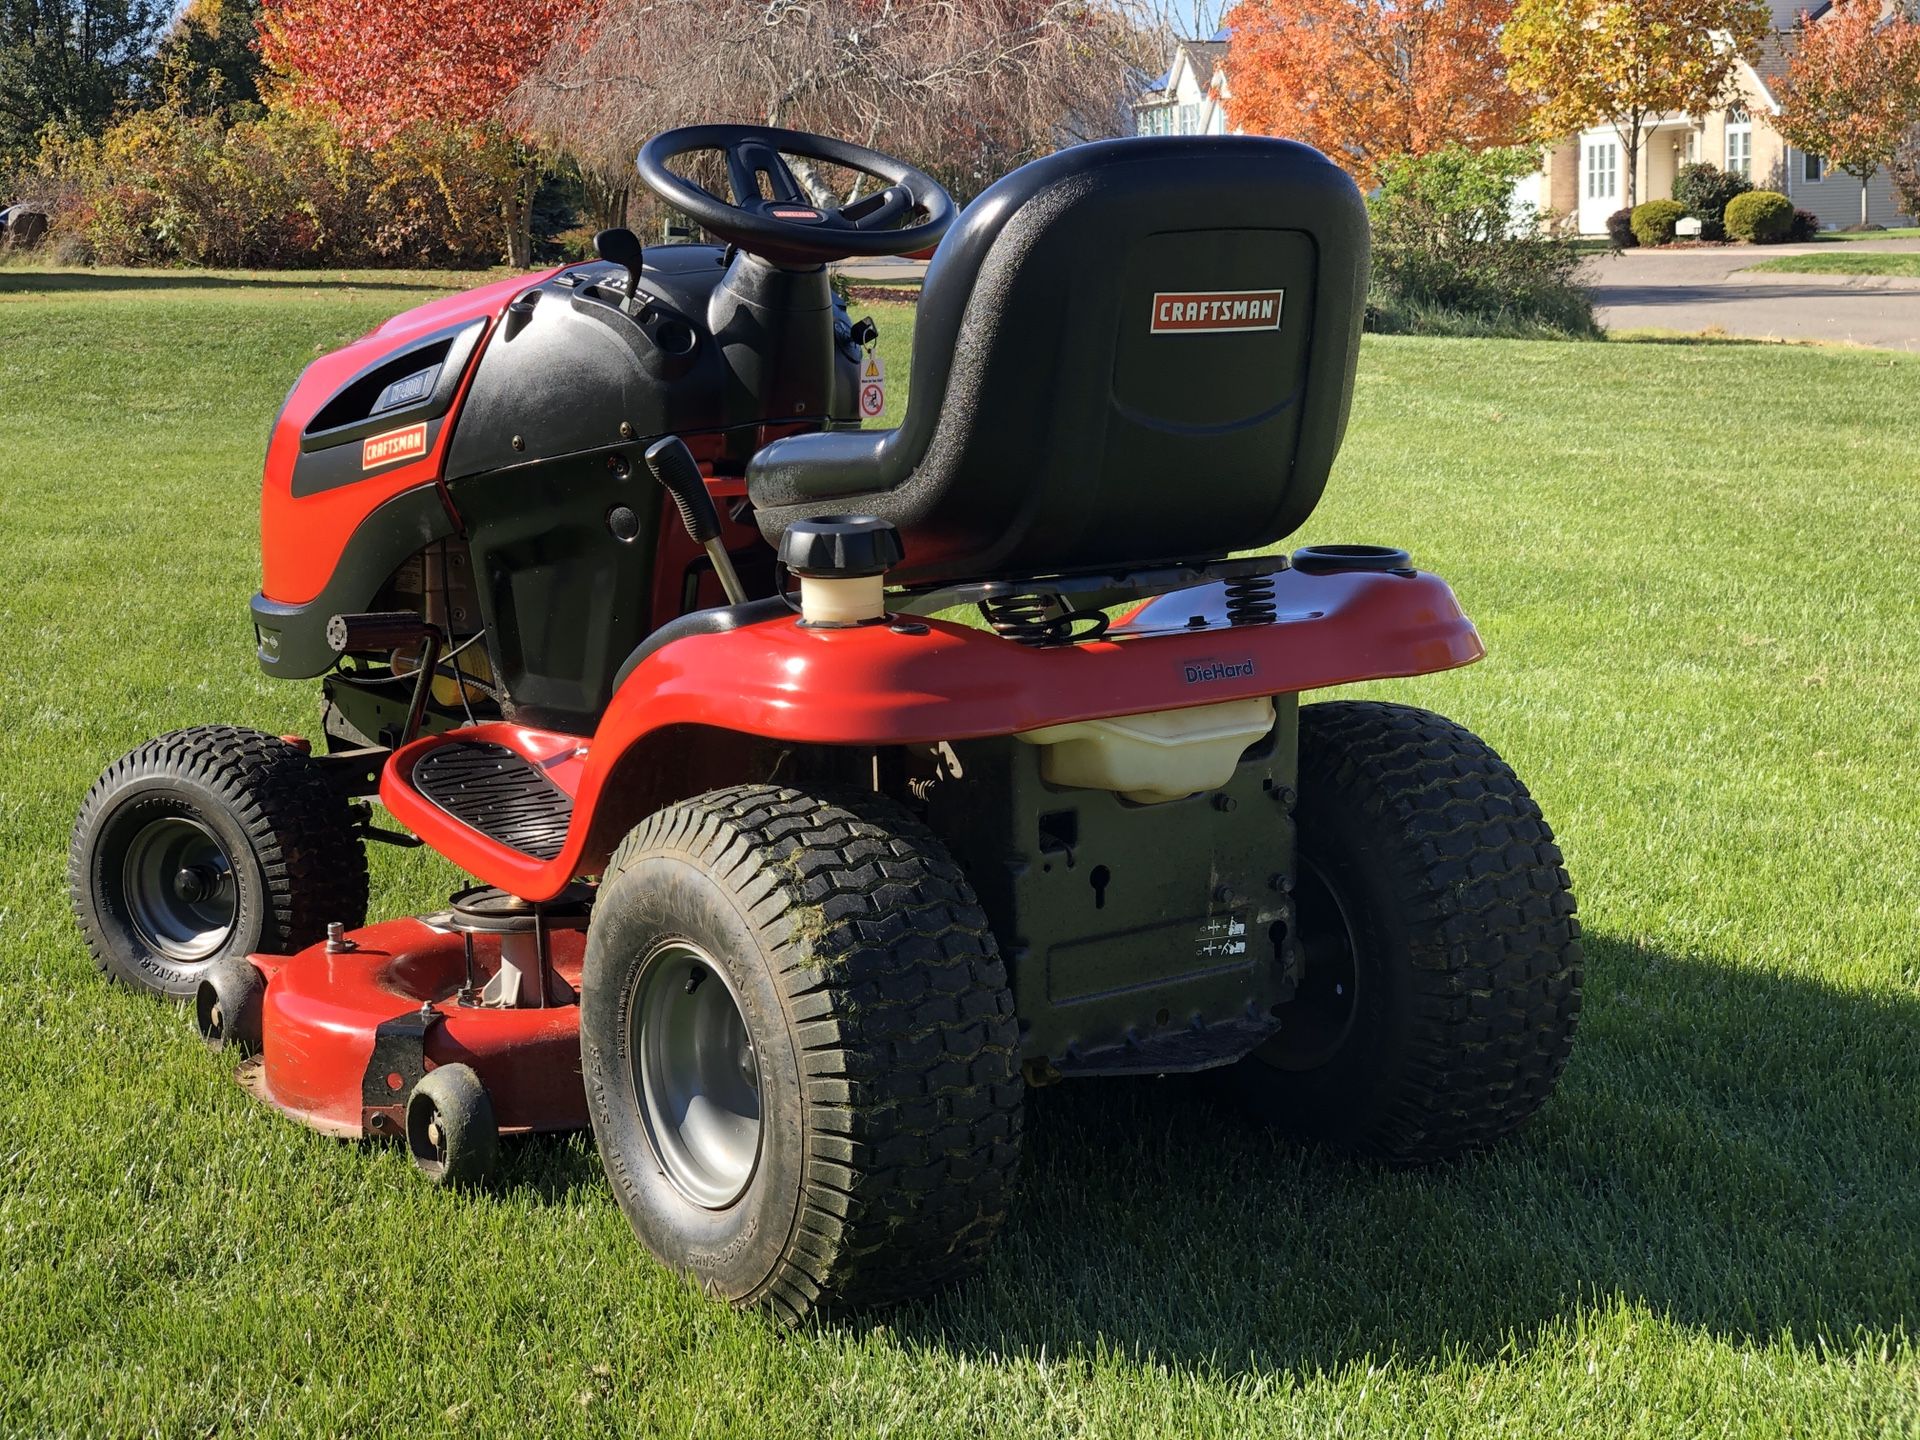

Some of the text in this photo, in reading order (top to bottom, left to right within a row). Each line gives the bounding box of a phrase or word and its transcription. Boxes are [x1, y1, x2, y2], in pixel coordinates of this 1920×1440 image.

[1160, 300, 1273, 322] CRAFTSMAN
[366, 432, 422, 460] CRAFTSMAN
[1185, 659, 1254, 683] DieHard
[727, 954, 774, 1093] CARLISLE
